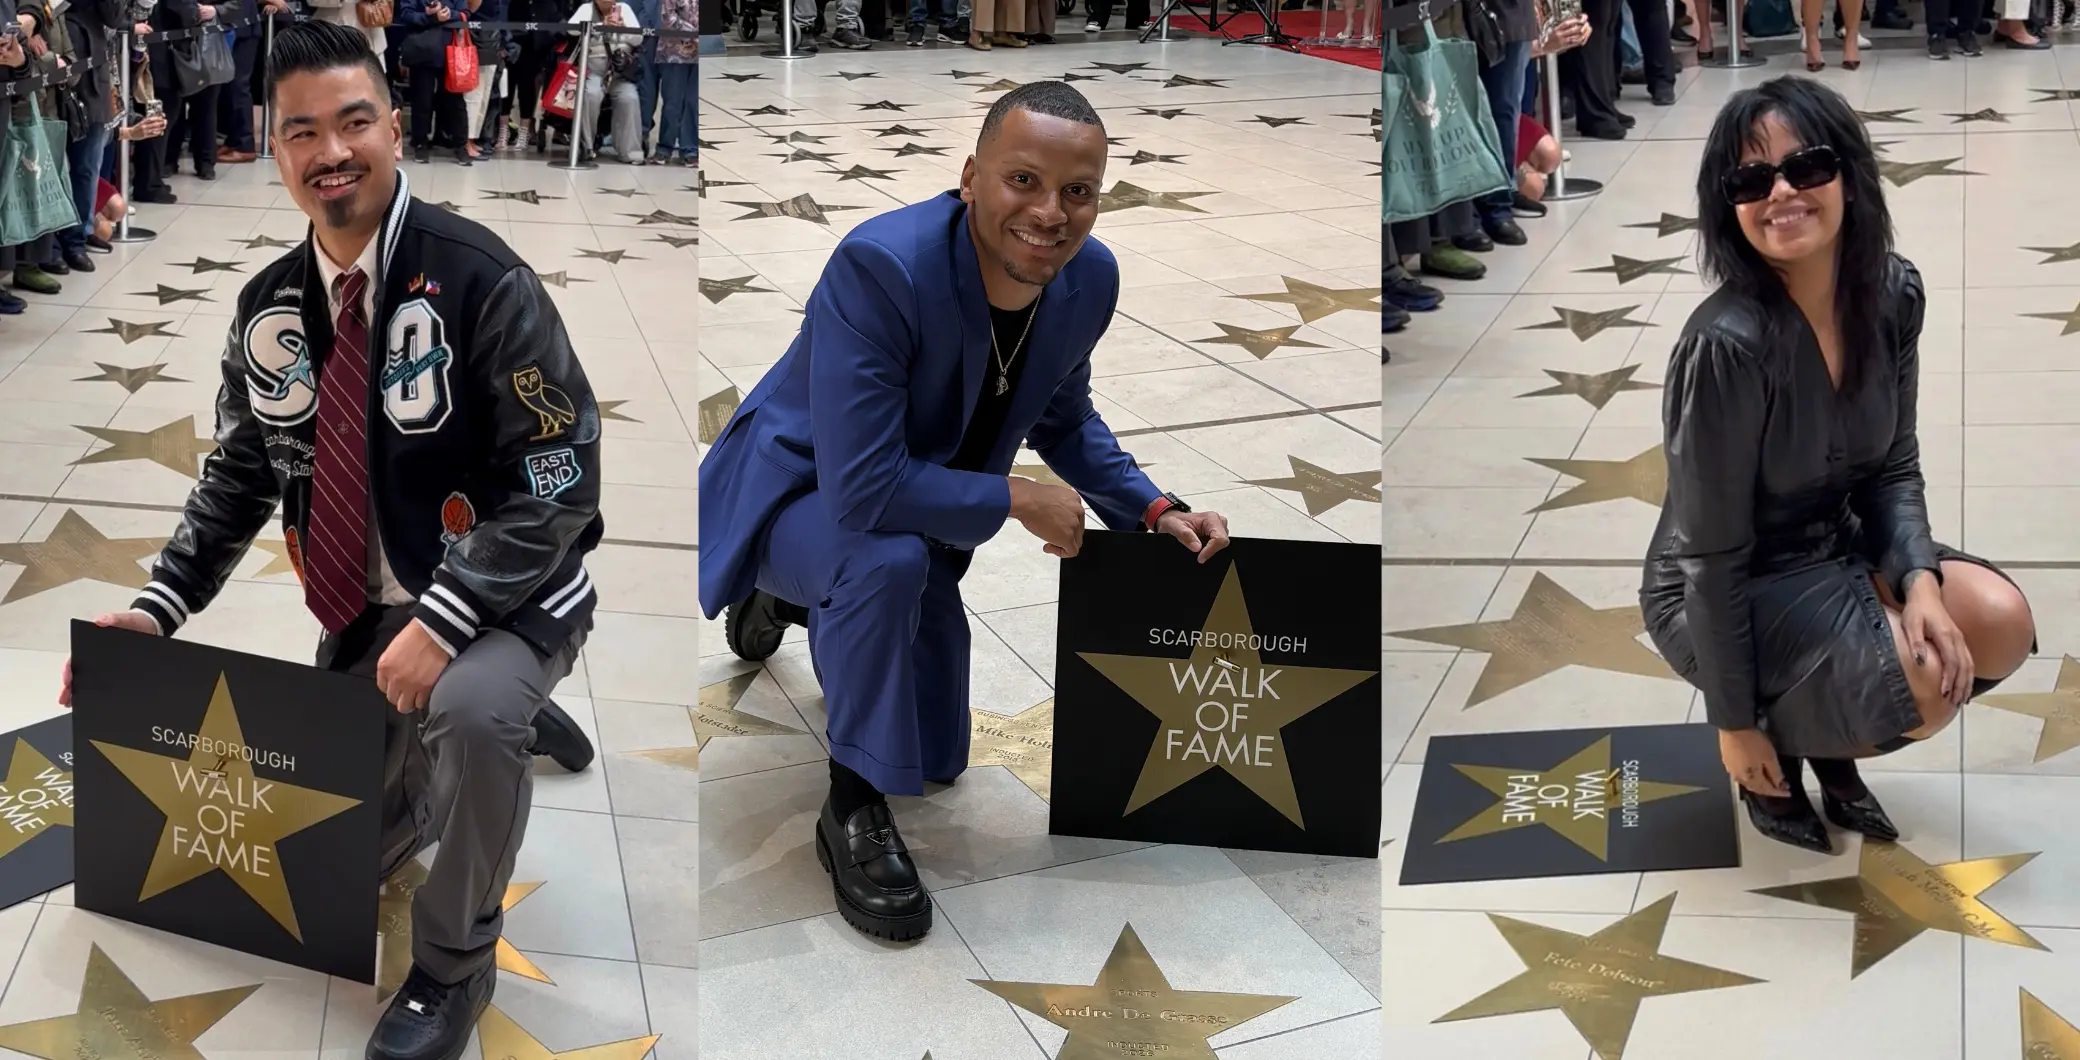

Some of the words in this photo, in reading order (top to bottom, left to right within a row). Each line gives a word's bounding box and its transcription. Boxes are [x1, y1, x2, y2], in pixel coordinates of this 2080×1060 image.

[468, 21, 482, 29] STC
[525, 22, 539, 31] STC
[642, 28, 656, 36] STC
[531, 452, 570, 473] EAST
[536, 466, 573, 496] END
[1148, 628, 1308, 653] SCARBOROUGH
[1168, 662, 1283, 700] WALK
[1195, 701, 1249, 733] OF
[976, 725, 1014, 740] Mike
[152, 726, 296, 772] SCARBOROUGH
[1166, 729, 1275, 767] FAME
[18, 788, 59, 810] OF
[170, 762, 274, 814] WALK
[1502, 774, 1540, 824] FAME
[1537, 784, 1570, 808] OF
[1573, 769, 1606, 821] WALK
[1622, 760, 1639, 828] SCARBOROUGH
[197, 804, 245, 839] OF
[173, 825, 271, 877] FAME
[1046, 1003, 1113, 1019] Andre
[1123, 1008, 1151, 1021] De
[1160, 1010, 1229, 1025] Grasse
[1107, 1040, 1170, 1051] INDUCTED
